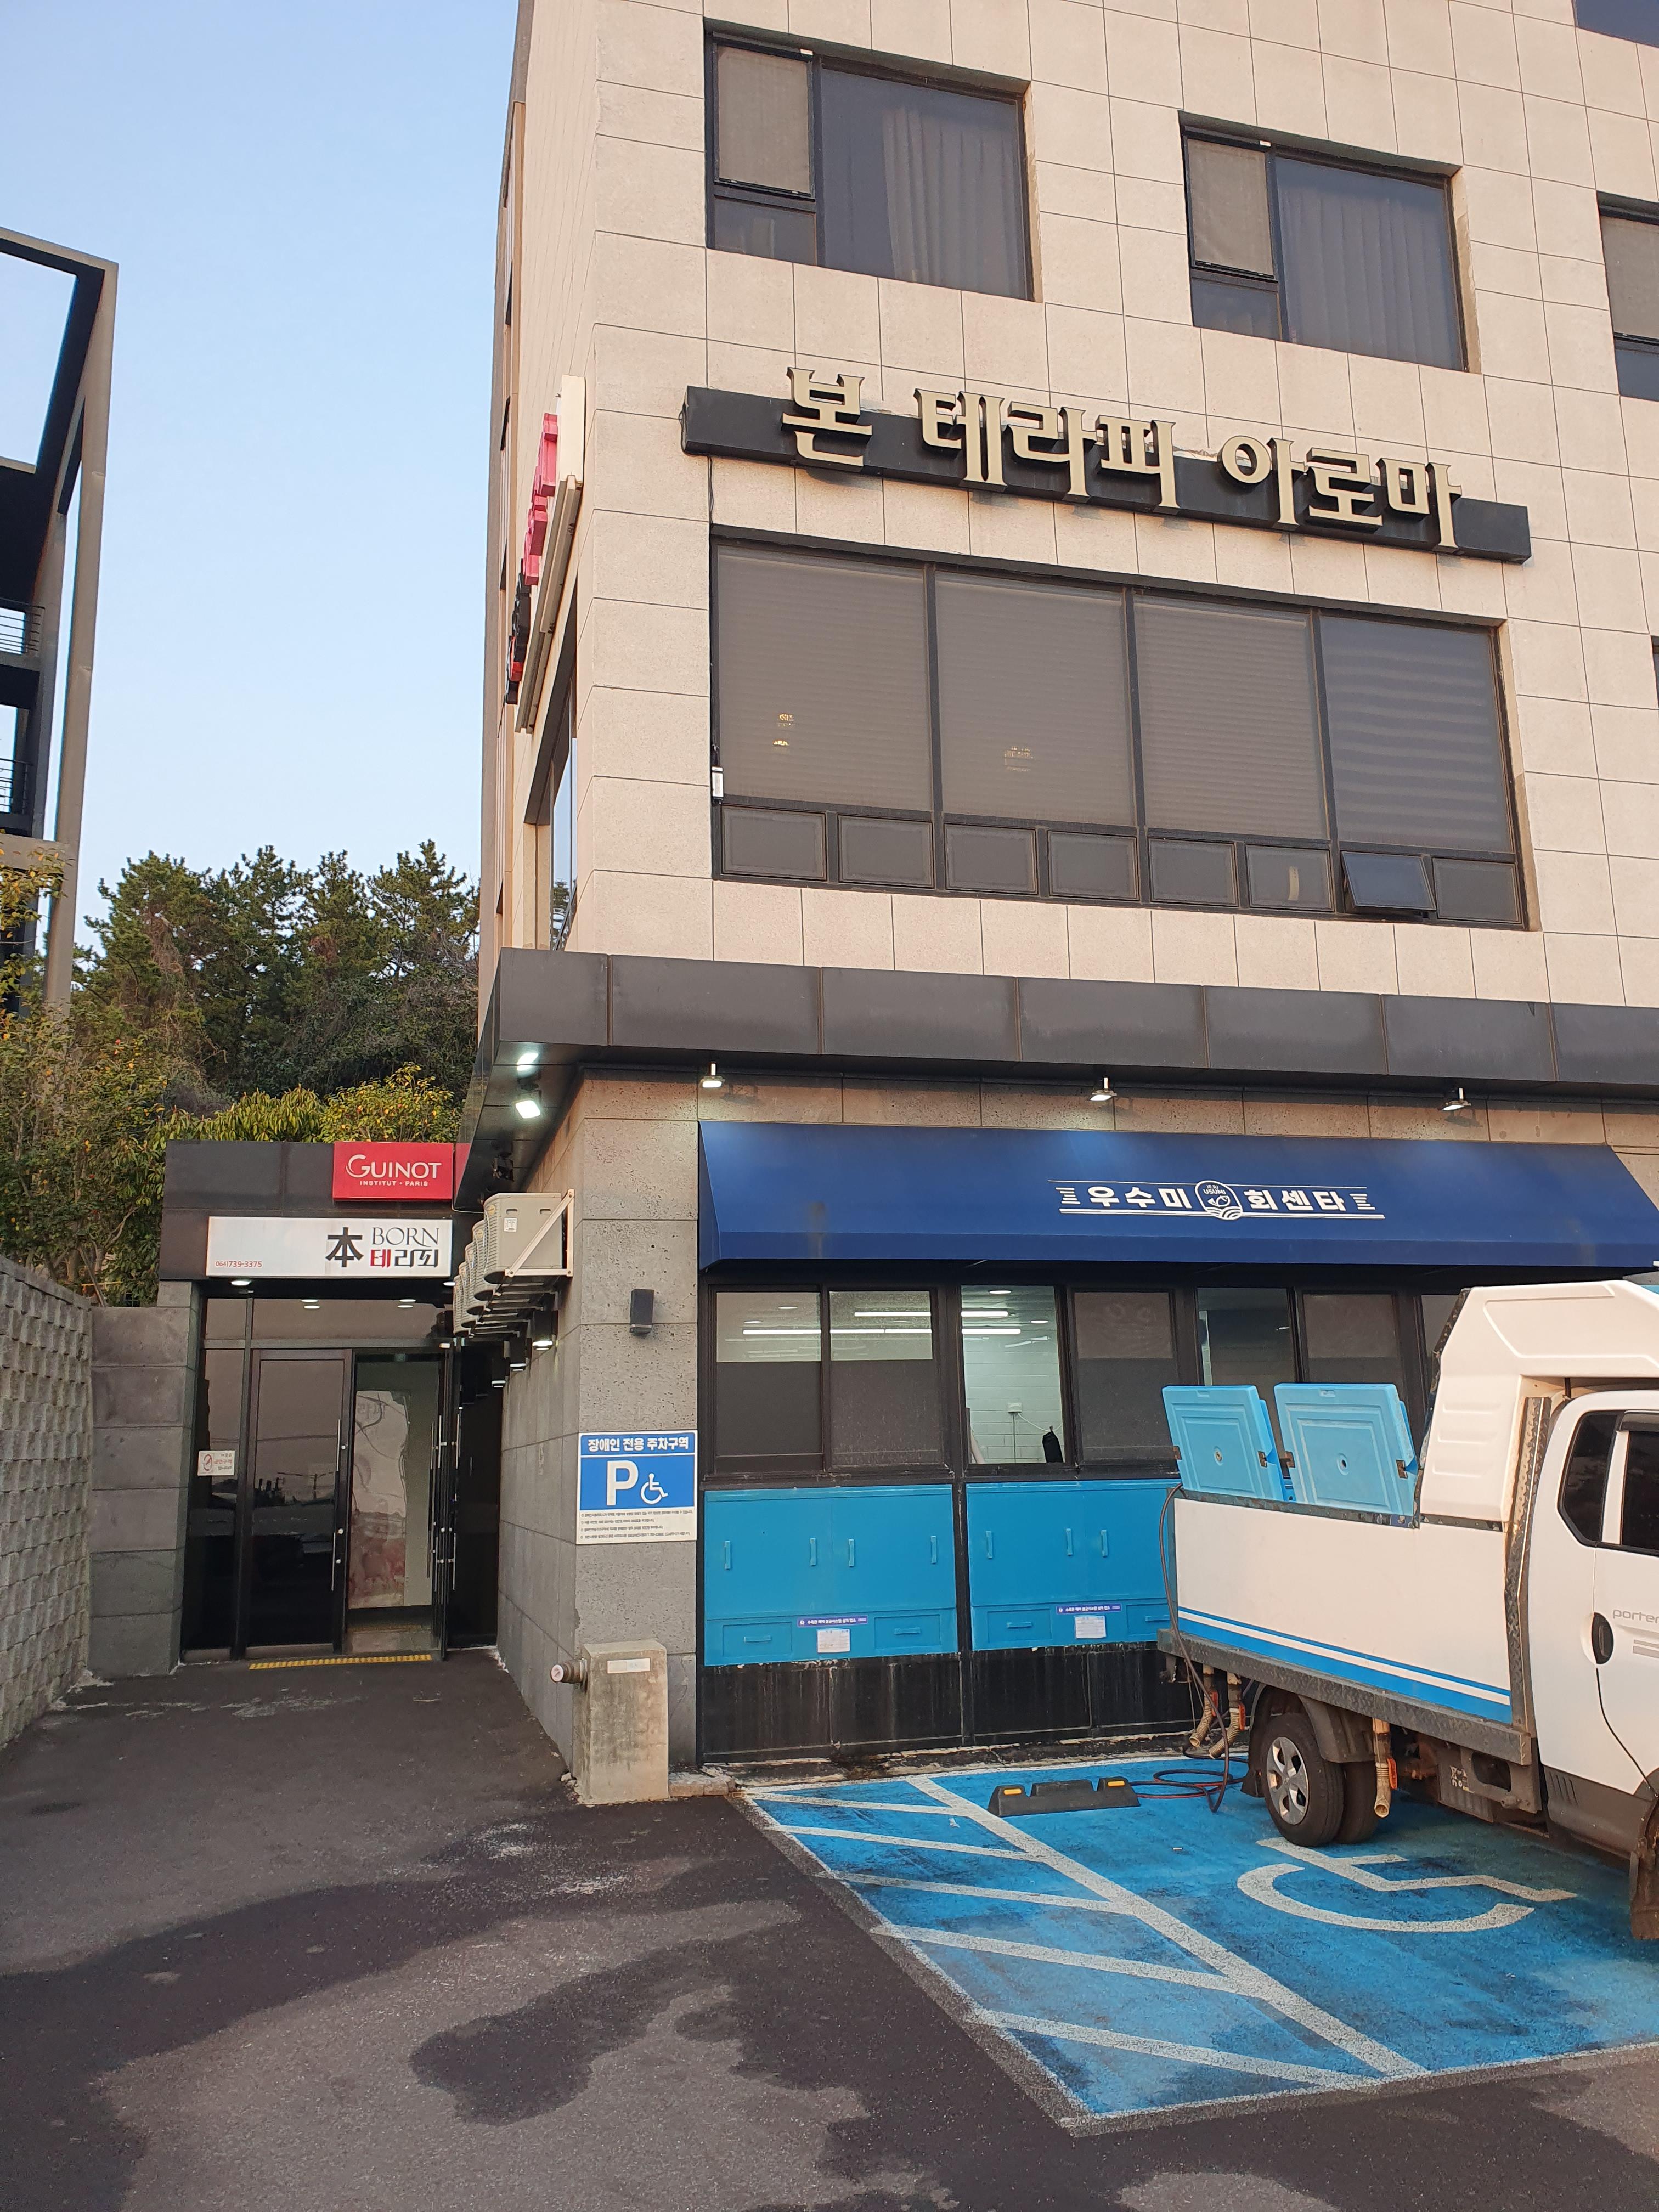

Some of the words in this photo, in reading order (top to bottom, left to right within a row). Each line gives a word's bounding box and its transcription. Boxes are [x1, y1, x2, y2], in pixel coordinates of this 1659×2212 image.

[782, 367, 873, 469] 본
[913, 387, 1180, 510] 테라피
[1218, 432, 1462, 552] 아로마
[346, 1154, 442, 1178] GUINOT
[1087, 1186, 1193, 1209] 우수미
[1243, 1189, 1347, 1211] 회센타
[325, 1227, 364, 1268] 本
[371, 1227, 439, 1247] BORN
[588, 1438, 620, 1452] 장애인
[623, 1437, 645, 1451] 전용
[647, 1436, 689, 1451] 주차구역
[606, 1460, 639, 1506] P
